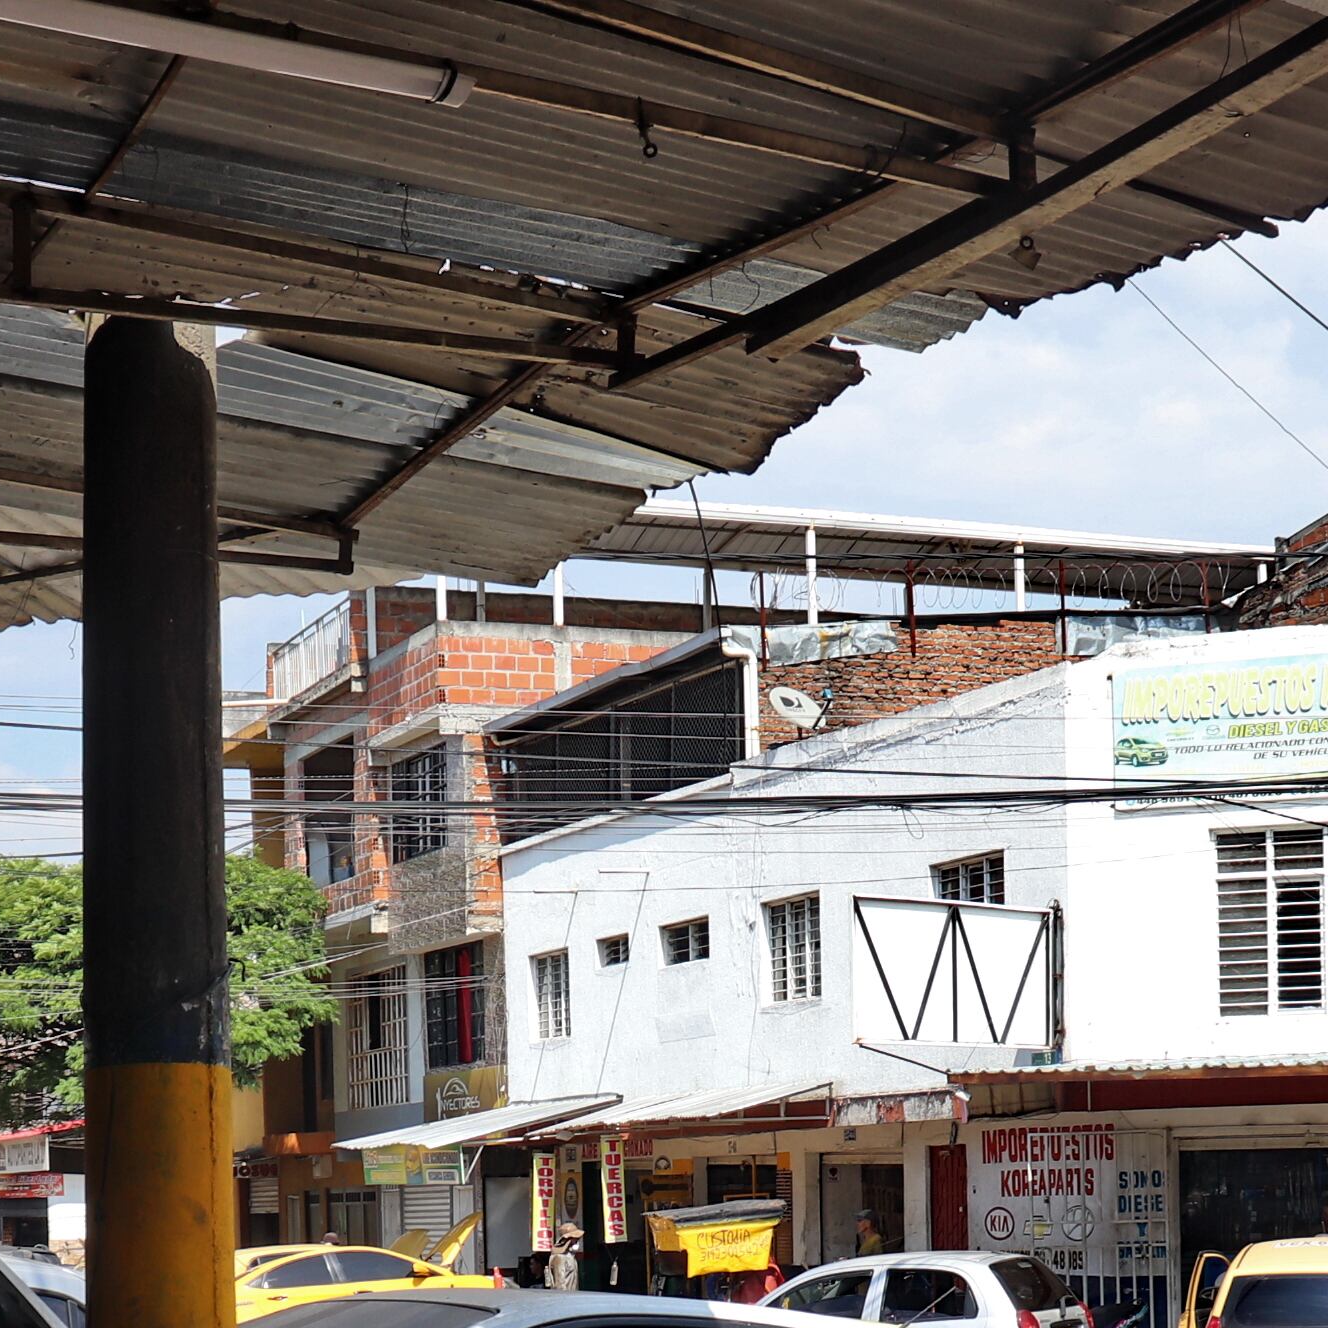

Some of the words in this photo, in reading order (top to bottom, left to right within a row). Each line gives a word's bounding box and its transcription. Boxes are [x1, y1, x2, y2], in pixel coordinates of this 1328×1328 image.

[1228, 720, 1283, 739] DIESEL
[1286, 722, 1296, 735] Y
[1174, 744, 1204, 755] TODO
[1225, 738, 1306, 751] RELACIONADO
[1253, 752, 1268, 760] DE
[1272, 750, 1288, 758] SU
[605, 1140, 624, 1236] TUERCAS
[537, 1157, 553, 1249] TORNILLOS
[989, 1215, 1009, 1232] KIA
